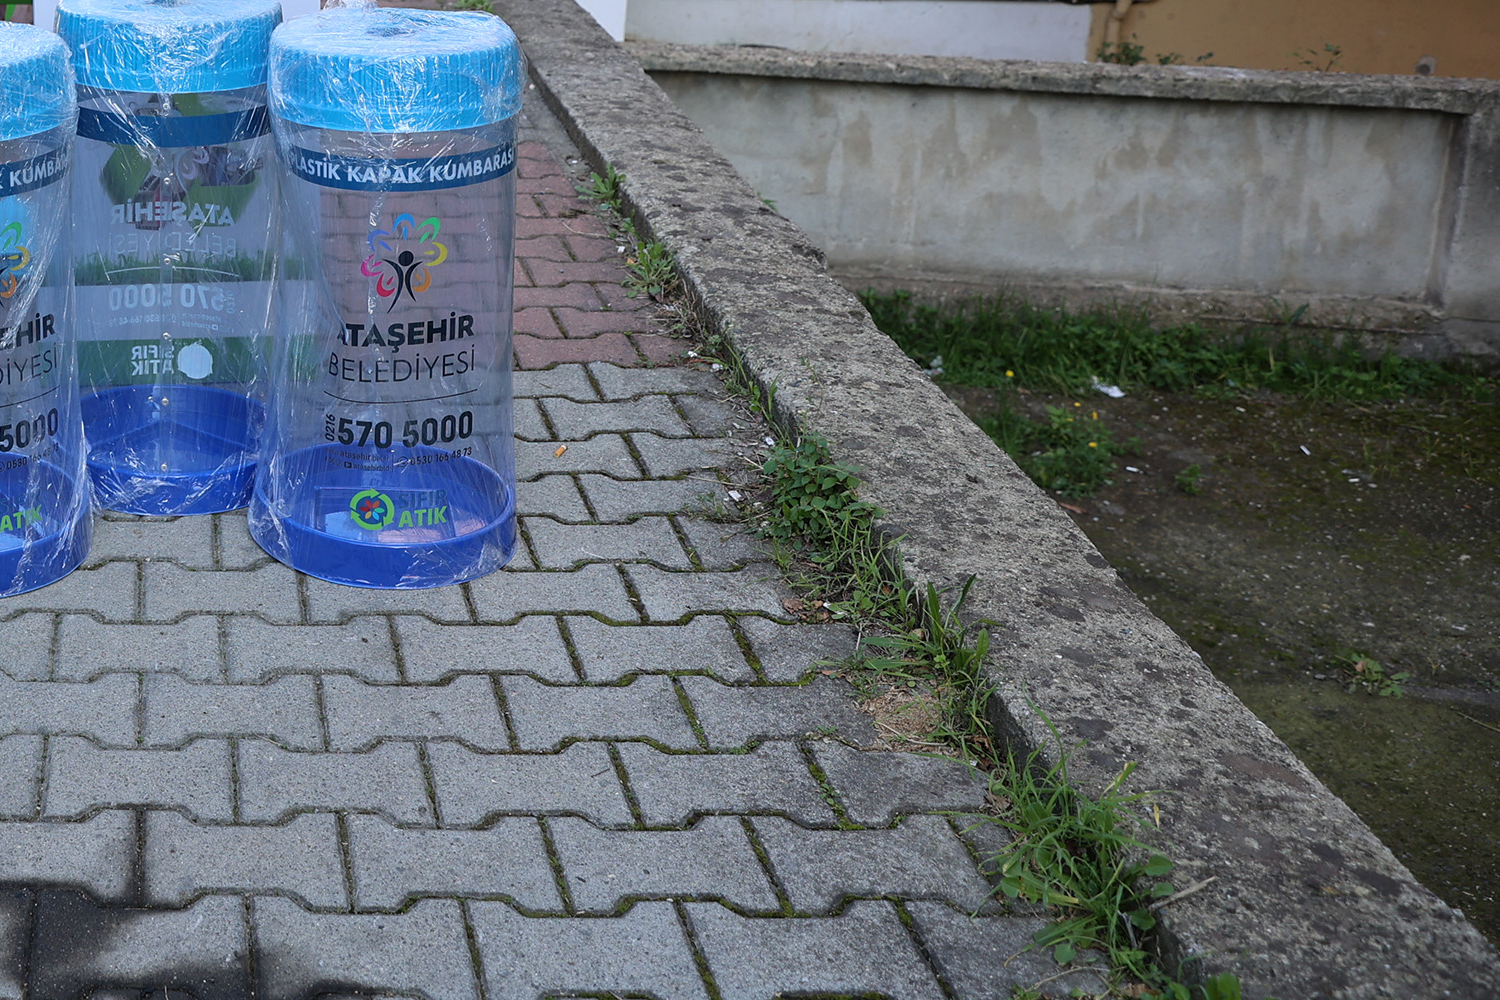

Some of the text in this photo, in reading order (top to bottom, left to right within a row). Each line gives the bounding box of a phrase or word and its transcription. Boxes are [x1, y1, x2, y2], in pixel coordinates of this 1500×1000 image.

[348, 164, 422, 183] KAPAK
[337, 311, 475, 353] ATAŞEHİR
[328, 344, 475, 383] BELEDİYESİ
[325, 411, 473, 449] 0216 570 5000
[410, 455, 433, 466] 0530
[435, 452, 449, 463] 166
[451, 450, 461, 460] 48
[463, 447, 472, 457] 73
[397, 489, 447, 508] SIFIR
[0, 504, 43, 533] ATIK
[398, 505, 447, 528] ATIK
